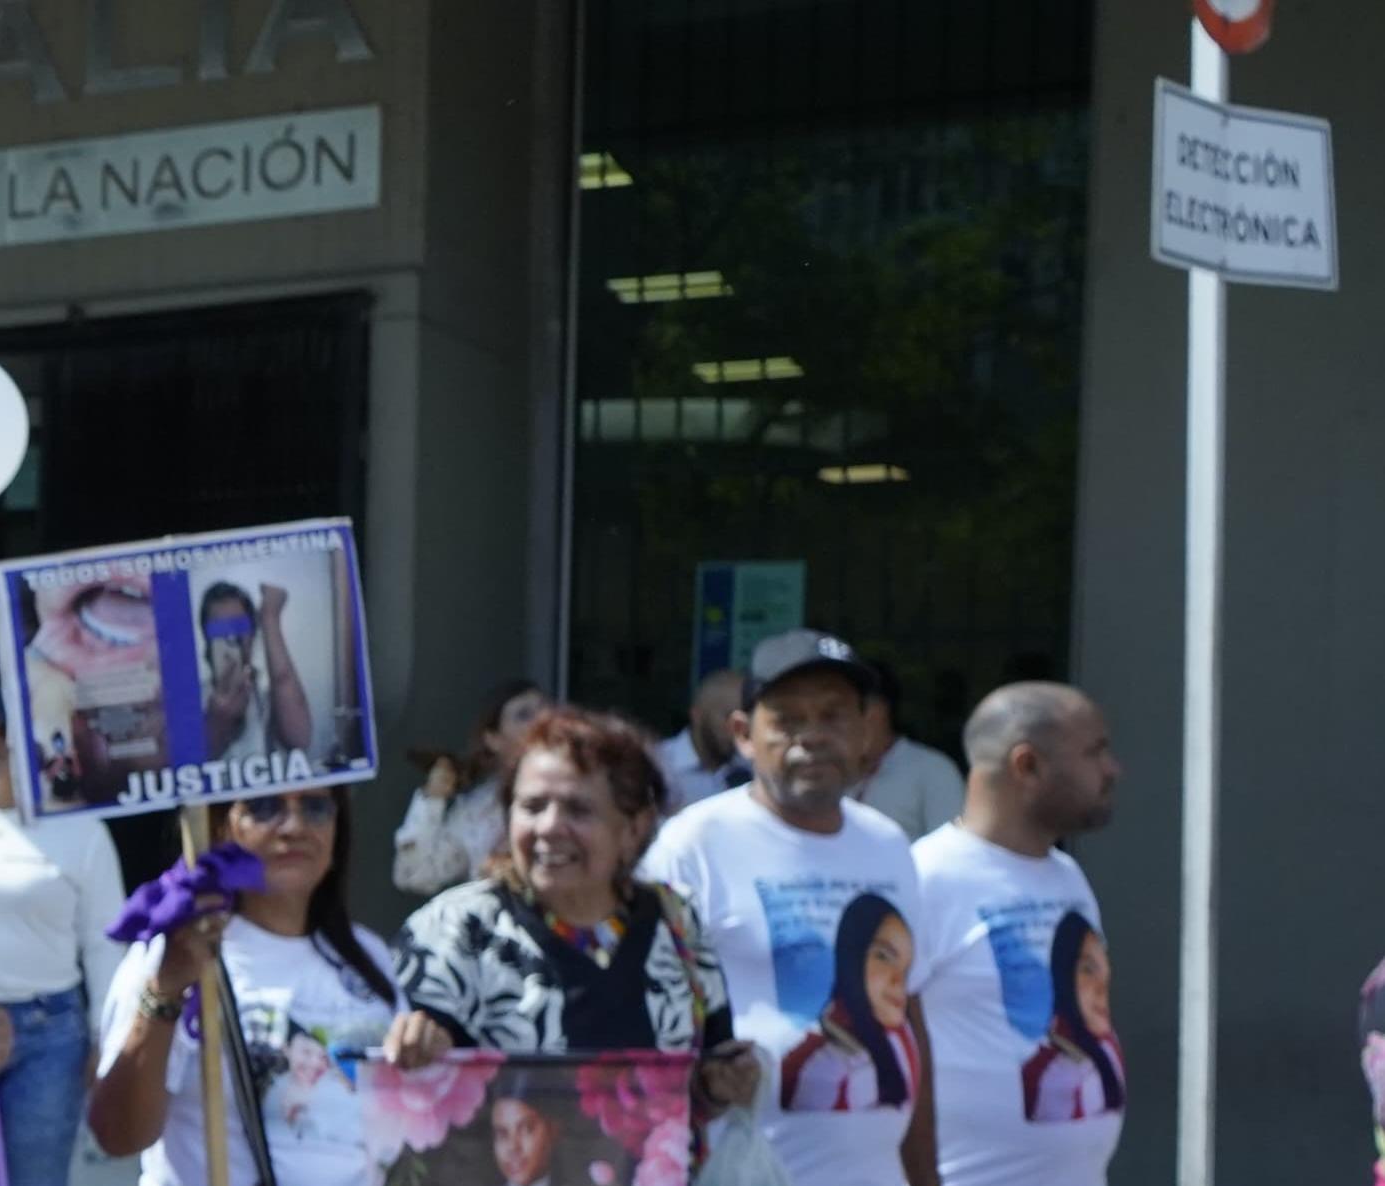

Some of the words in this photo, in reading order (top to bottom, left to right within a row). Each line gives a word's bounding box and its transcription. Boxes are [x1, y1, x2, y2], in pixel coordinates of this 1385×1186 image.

[7, 166, 83, 221] LA
[100, 123, 356, 212] NACIÓN
[1164, 189, 1323, 251] ELECTRÓNICA
[21, 558, 111, 591] TODOS
[115, 545, 206, 580] SOMOS
[210, 528, 345, 567] VALENTINA
[116, 747, 315, 806] JUSTICIA
